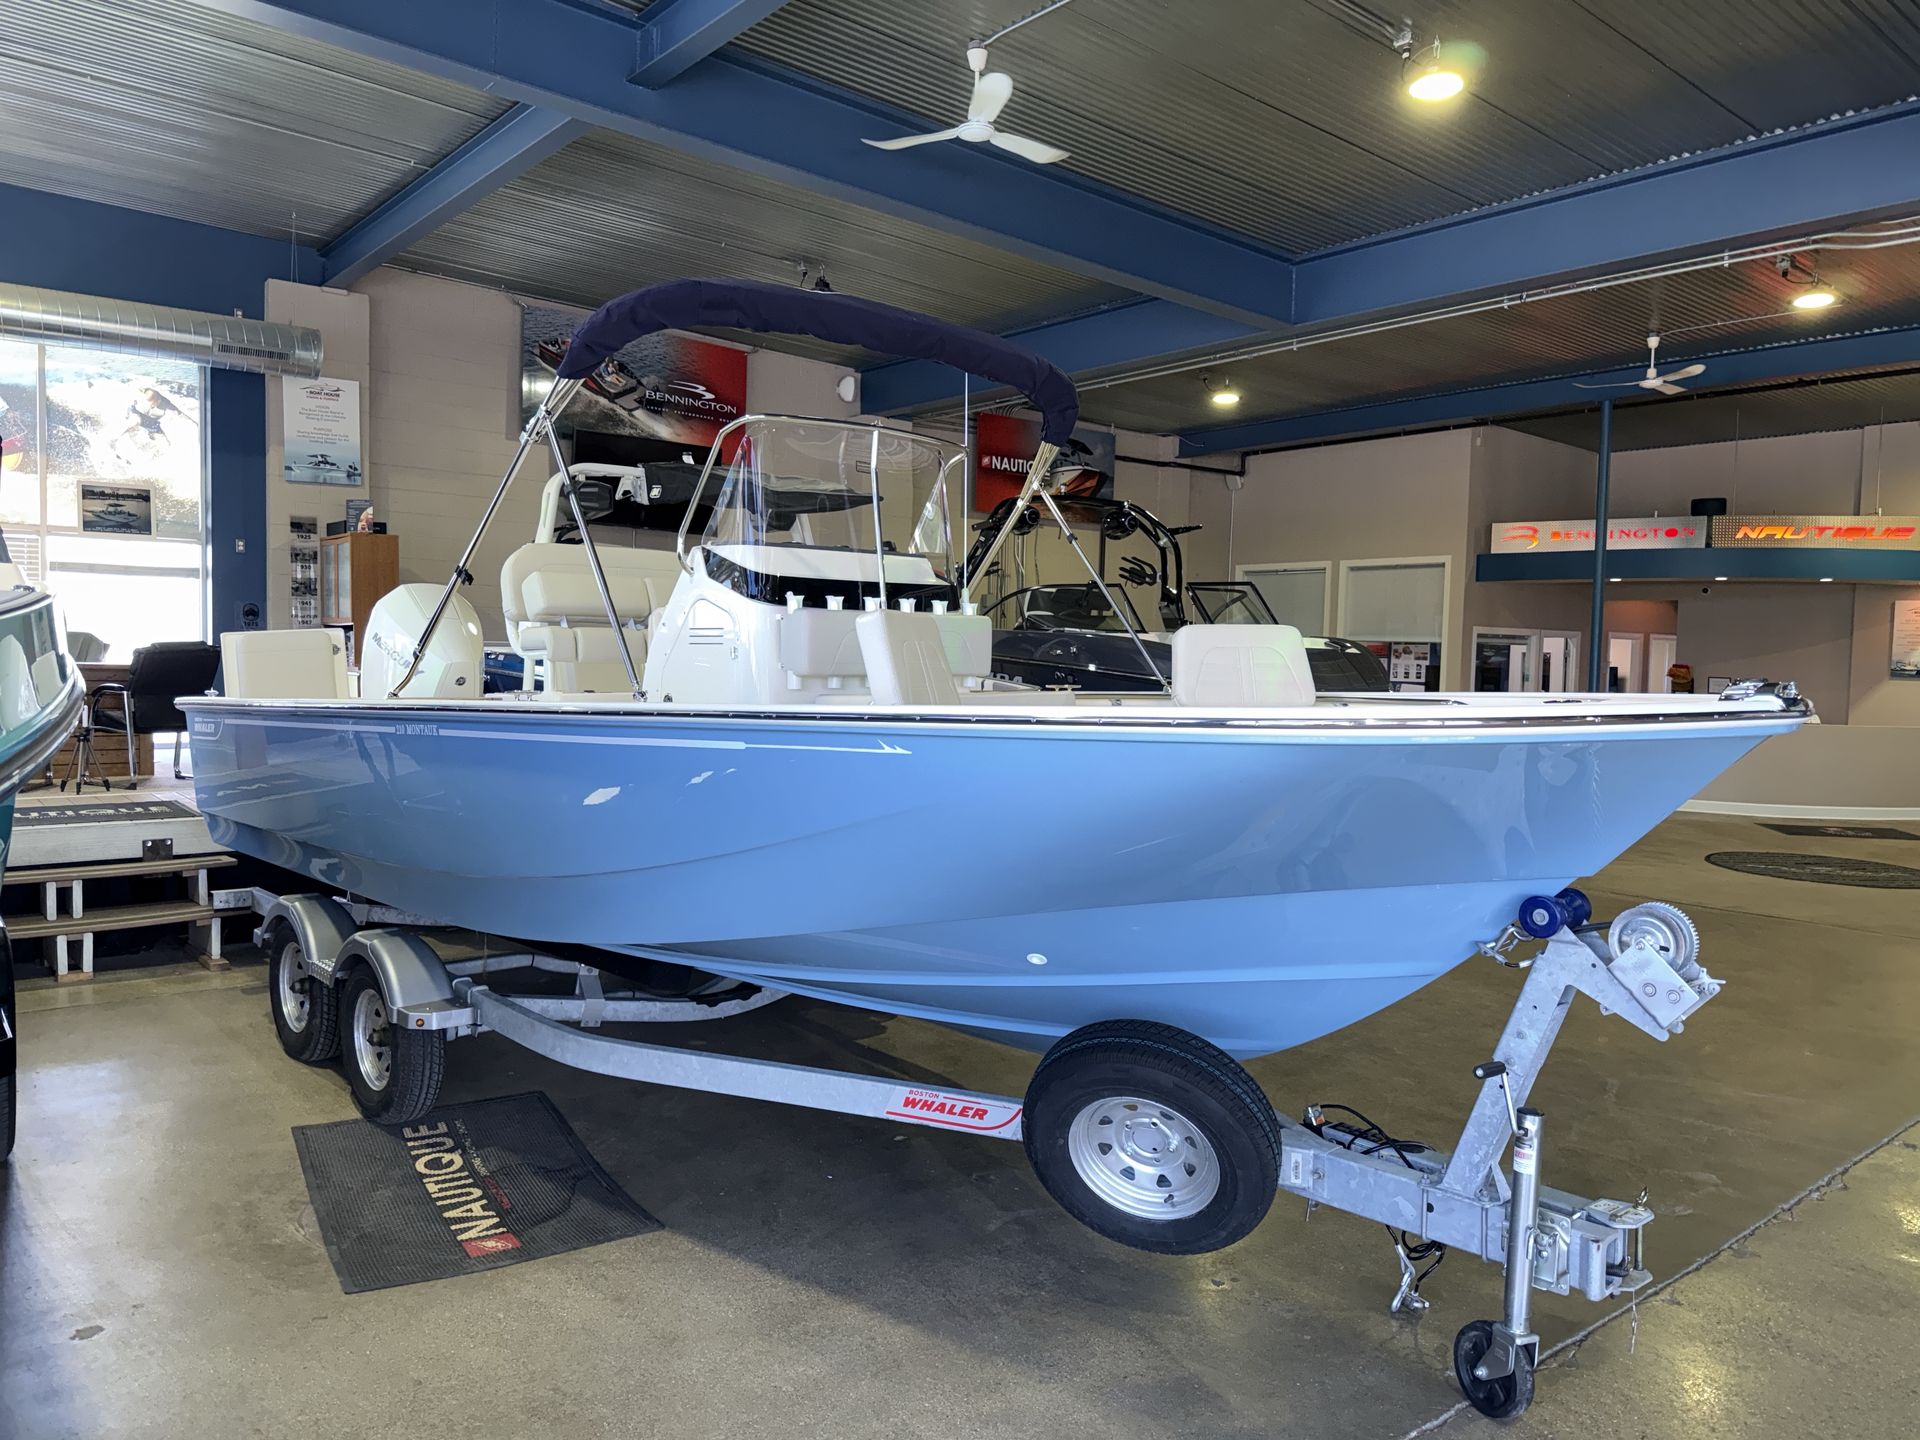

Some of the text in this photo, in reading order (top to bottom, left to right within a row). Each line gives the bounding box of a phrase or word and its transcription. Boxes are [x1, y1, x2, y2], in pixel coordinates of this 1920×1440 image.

[645, 390, 737, 414] BENNINGTON
[1550, 527, 1695, 541] BENINGTON
[1735, 526, 1917, 541] NAUTIQUE
[406, 724, 439, 736] MONTAUK
[908, 1089, 940, 1099] BOSTON
[902, 1096, 989, 1121] WHALER
[402, 1121, 508, 1241] NAUTIQUE
